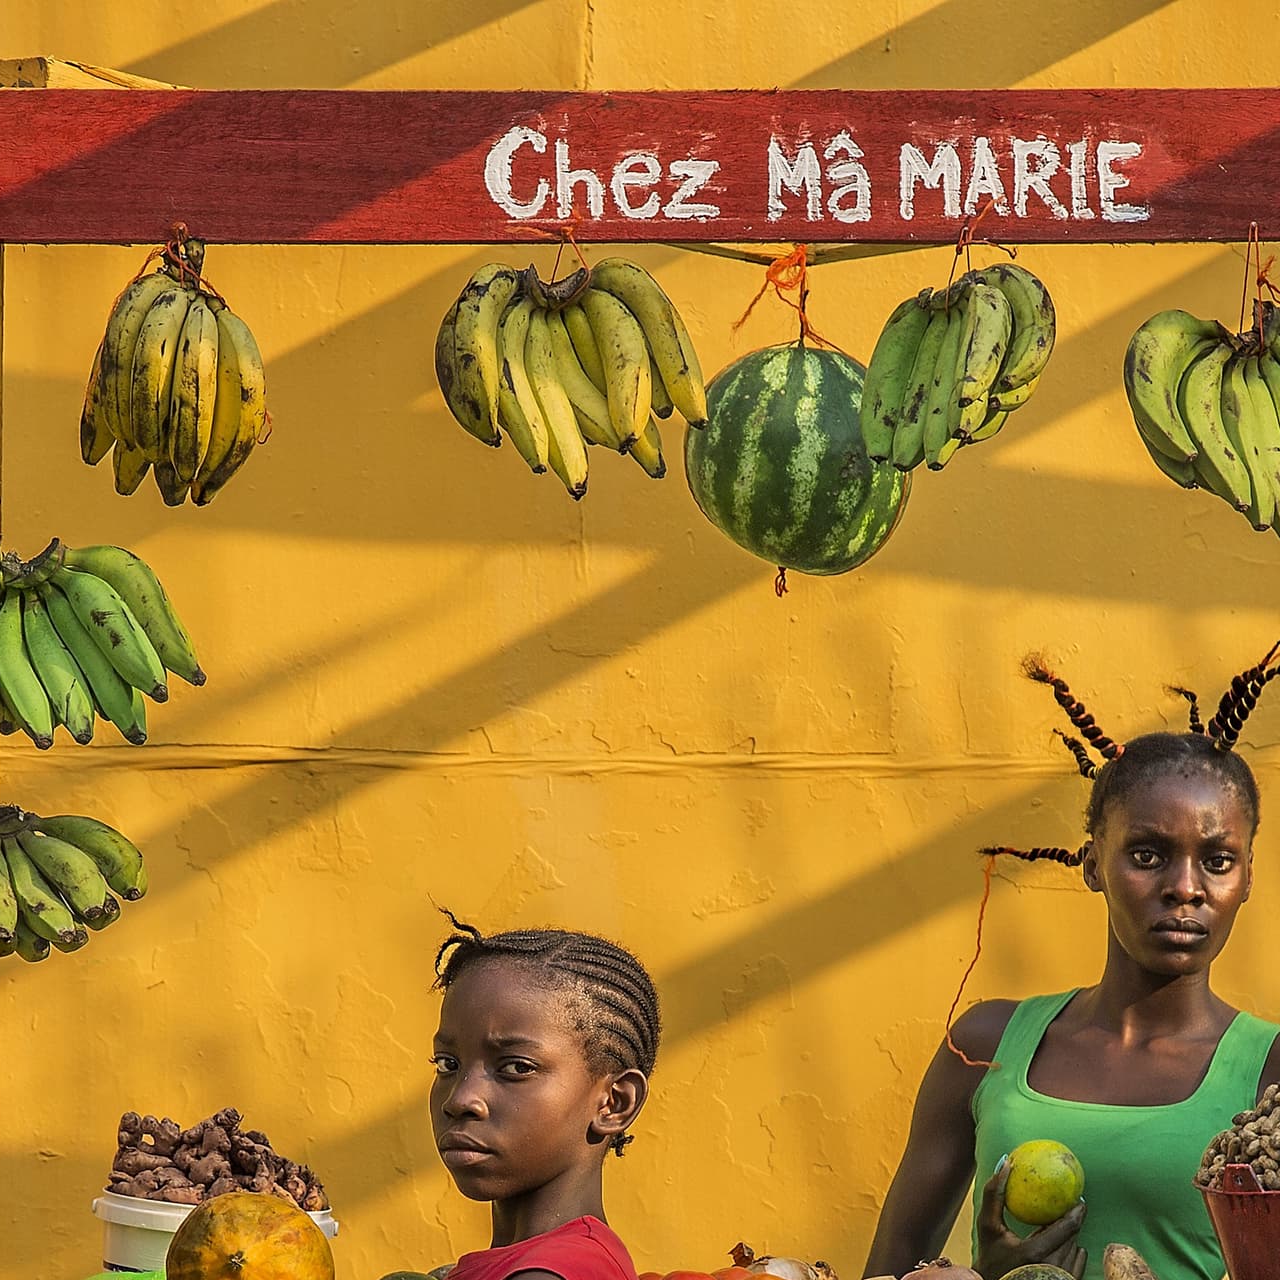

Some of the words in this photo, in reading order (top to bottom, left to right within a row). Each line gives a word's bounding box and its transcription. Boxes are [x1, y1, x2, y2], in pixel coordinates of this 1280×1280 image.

[484, 124, 722, 221] Chez
[767, 129, 872, 223] Mâ
[900, 135, 1151, 223] MARIE
